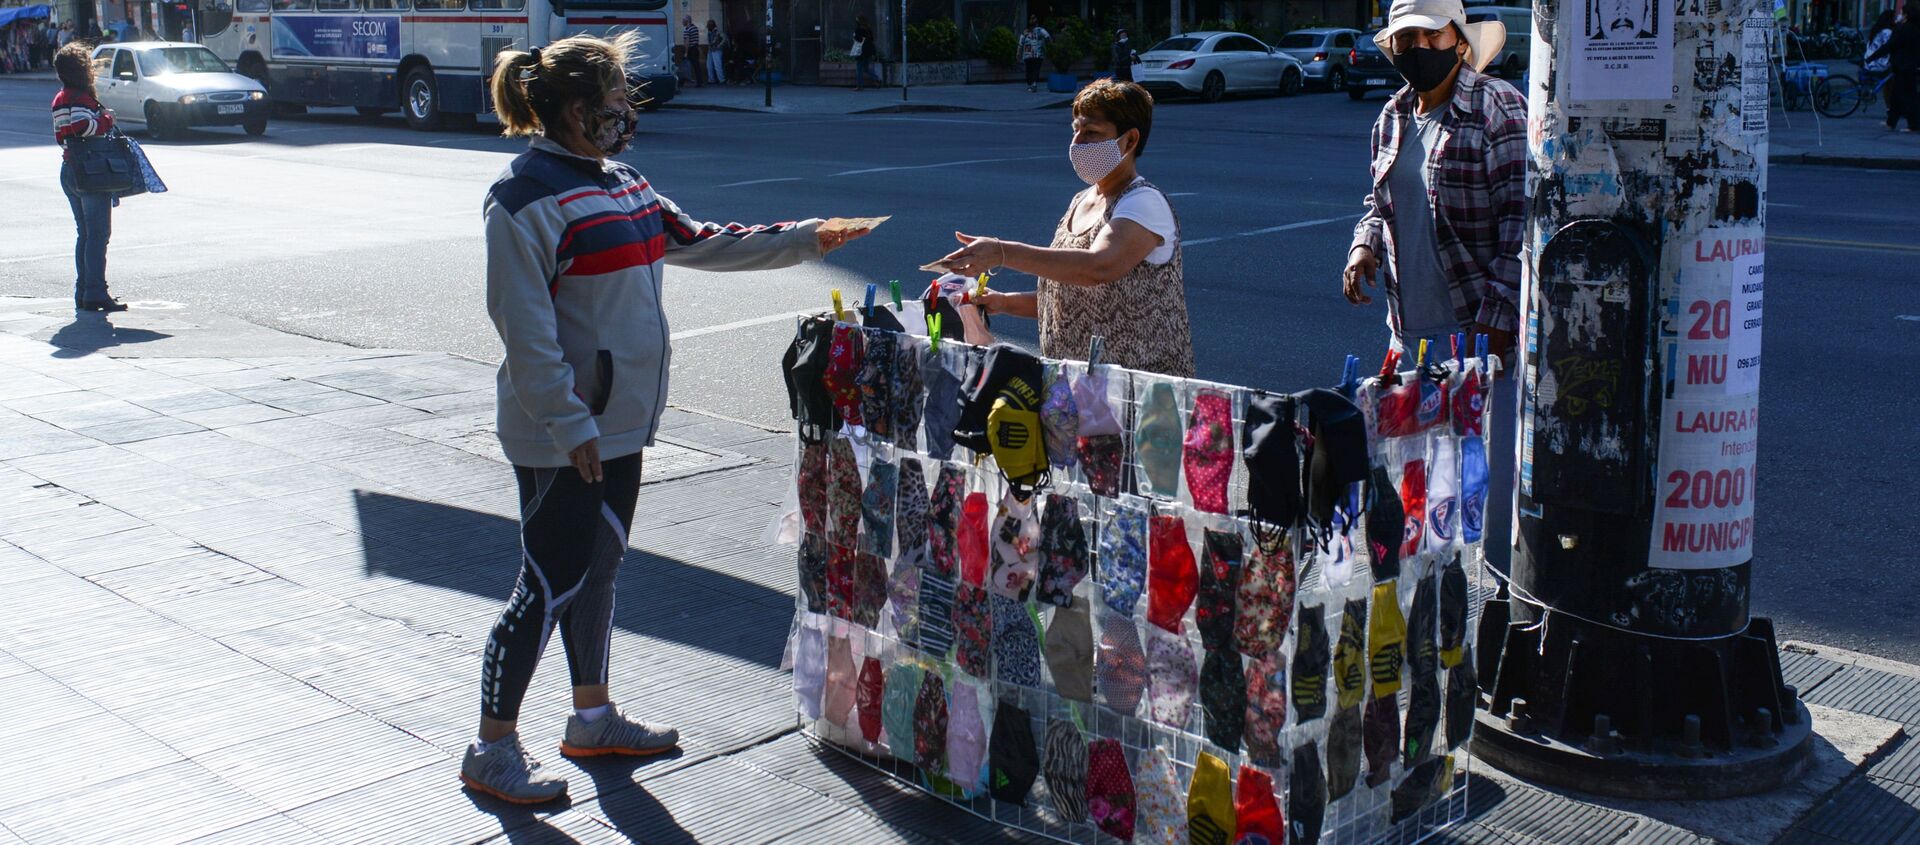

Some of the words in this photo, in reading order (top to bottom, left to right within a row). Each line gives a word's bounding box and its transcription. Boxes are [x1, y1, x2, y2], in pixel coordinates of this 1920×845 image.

[352, 21, 387, 36] SECOM
[492, 25, 504, 33] 301
[1686, 354, 1728, 385] MU
[1675, 409, 1747, 433] LAURA
[1665, 467, 1745, 509] 2000
